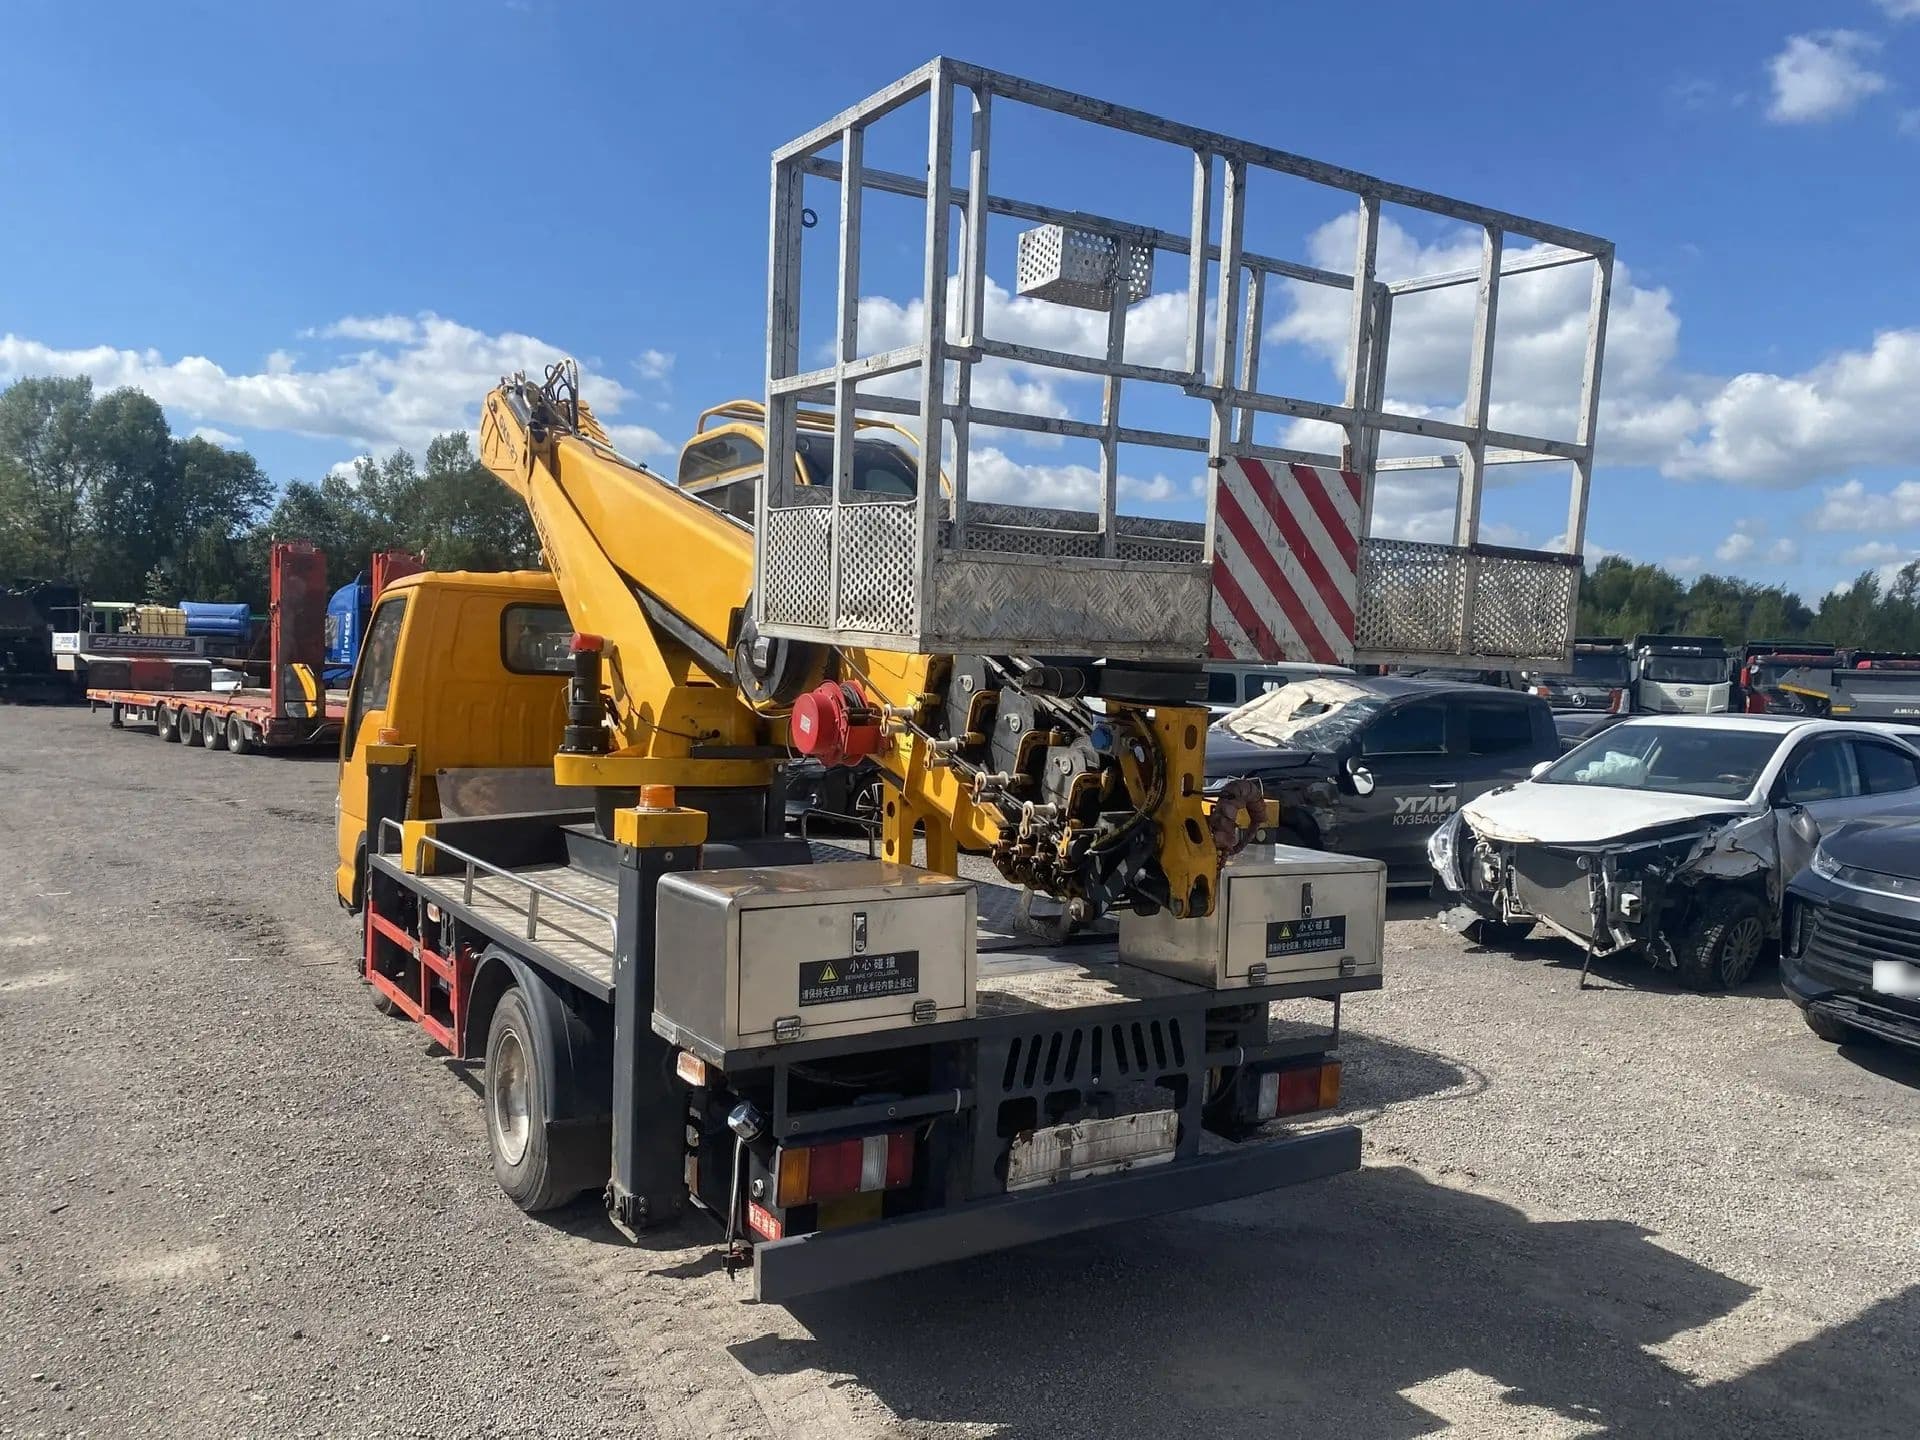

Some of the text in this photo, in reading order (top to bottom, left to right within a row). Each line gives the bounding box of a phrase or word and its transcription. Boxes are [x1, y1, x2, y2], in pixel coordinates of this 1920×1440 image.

[1394, 796, 1457, 813] УГЛИ
[1392, 813, 1454, 825] КУЗБАСС
[849, 956, 896, 973] 小心碰撞
